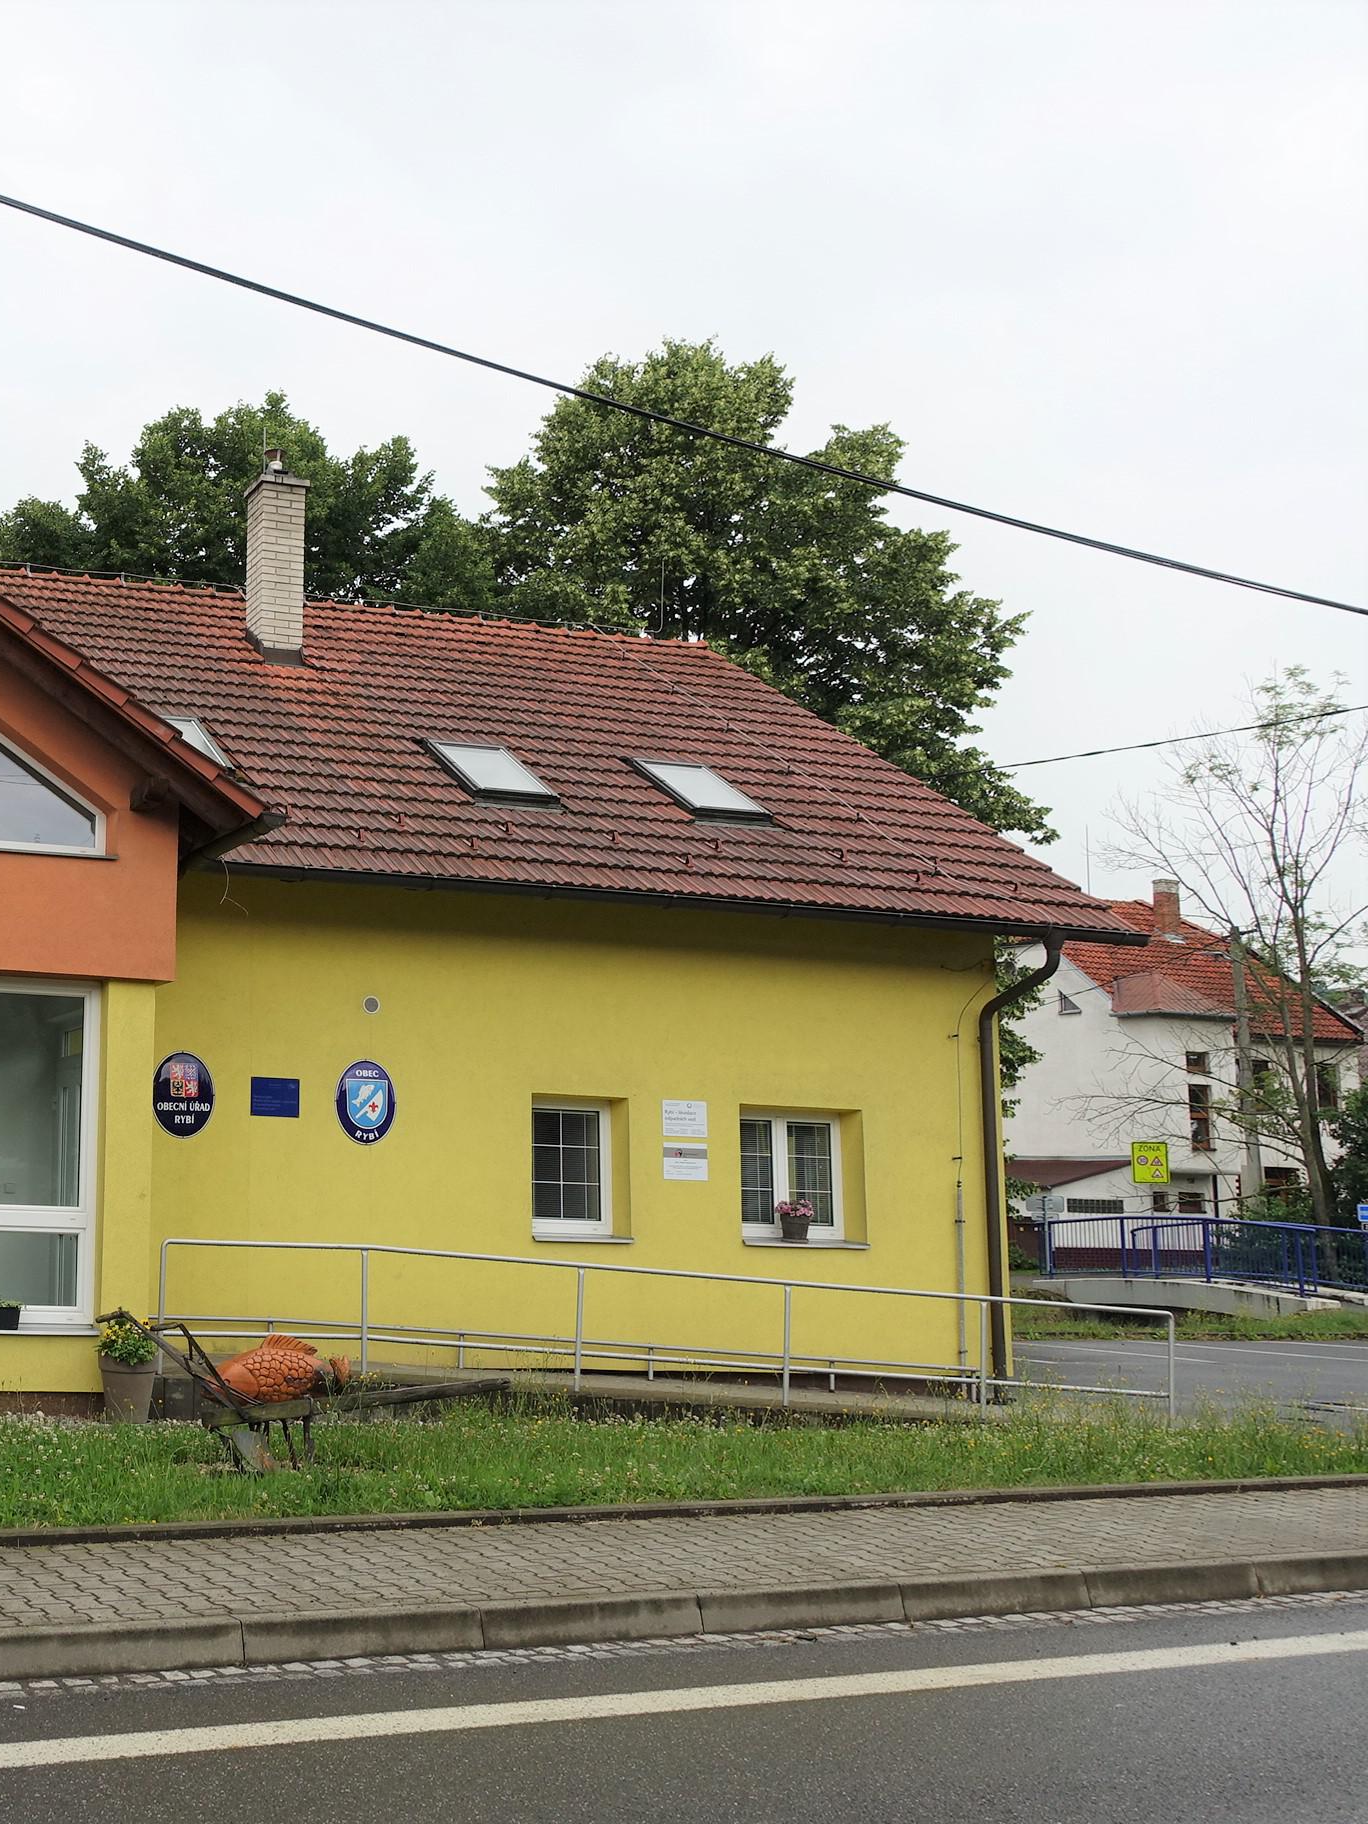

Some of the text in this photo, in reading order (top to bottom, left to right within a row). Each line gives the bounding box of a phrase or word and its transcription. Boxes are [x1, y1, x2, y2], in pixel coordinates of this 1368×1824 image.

[355, 1069, 379, 1078] OBEC
[157, 1101, 211, 1112] OBECNÍ ÚŘAD
[174, 1113, 195, 1124] RYBÍ
[355, 1129, 380, 1141] RYBÍ
[1138, 1144, 1161, 1153] ZONA
